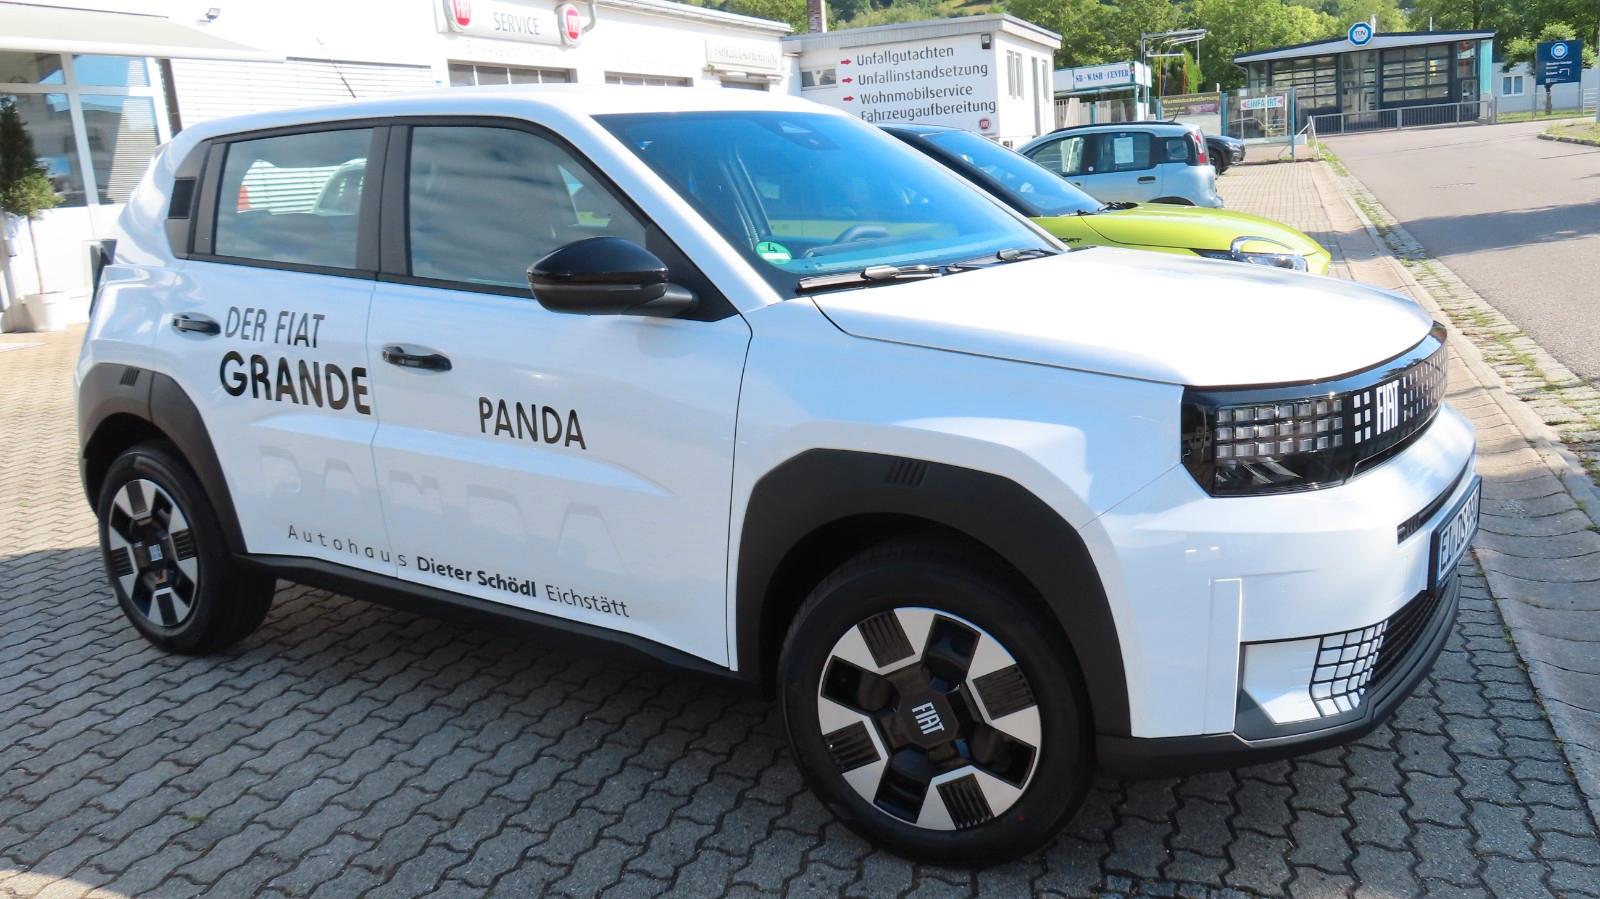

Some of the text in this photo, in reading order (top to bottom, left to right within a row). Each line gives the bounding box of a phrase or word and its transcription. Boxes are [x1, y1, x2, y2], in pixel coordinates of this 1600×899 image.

[493, 12, 541, 36] SERVICE
[856, 46, 954, 66] Unfallgutachten
[858, 64, 988, 86] Unfallinstandsetzung
[860, 84, 973, 105] Wohnmobilservice
[861, 101, 996, 122] Fahrzeugaufbereitung
[767, 242, 778, 252] 4
[225, 306, 326, 348] DER FIAT
[219, 350, 587, 450] GRANDE PANDA
[1375, 379, 1400, 435] FIAT
[287, 524, 630, 618] Autohaus Dieter Schödl Eichstätt
[911, 701, 945, 735] FIAT
